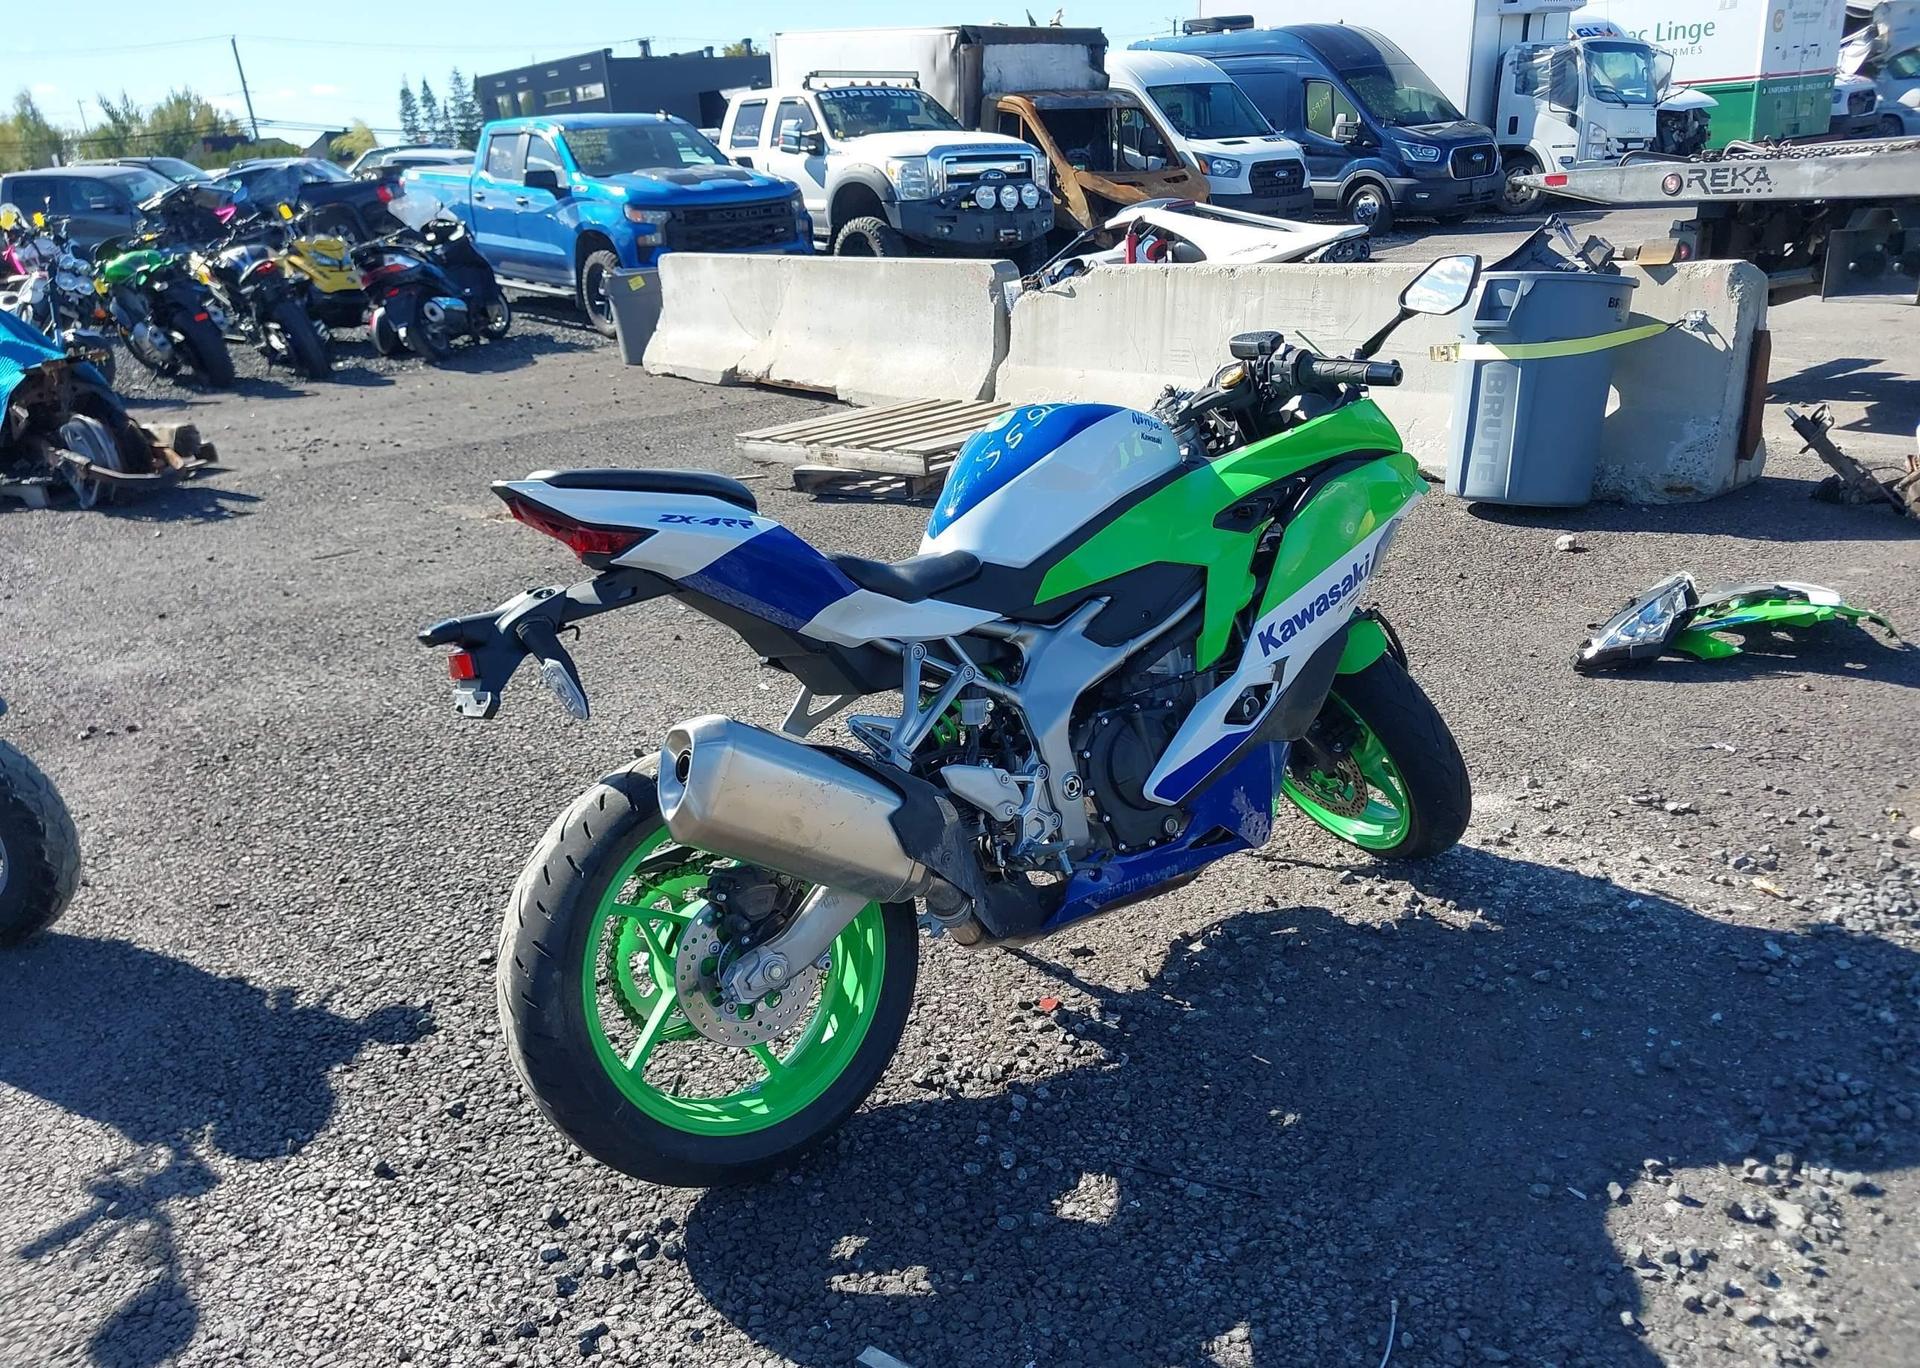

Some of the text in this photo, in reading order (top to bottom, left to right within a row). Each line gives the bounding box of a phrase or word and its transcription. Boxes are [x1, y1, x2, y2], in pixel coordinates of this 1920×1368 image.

[1656, 21, 1715, 44] Linge
[1687, 166, 1772, 194] REKA
[1132, 412, 1163, 432] Ninja
[1477, 371, 1507, 483] BRUTE
[1141, 432, 1163, 445] Kawasaki
[658, 514, 754, 529] ZX-4RR
[1257, 553, 1370, 657] Kawasaki
